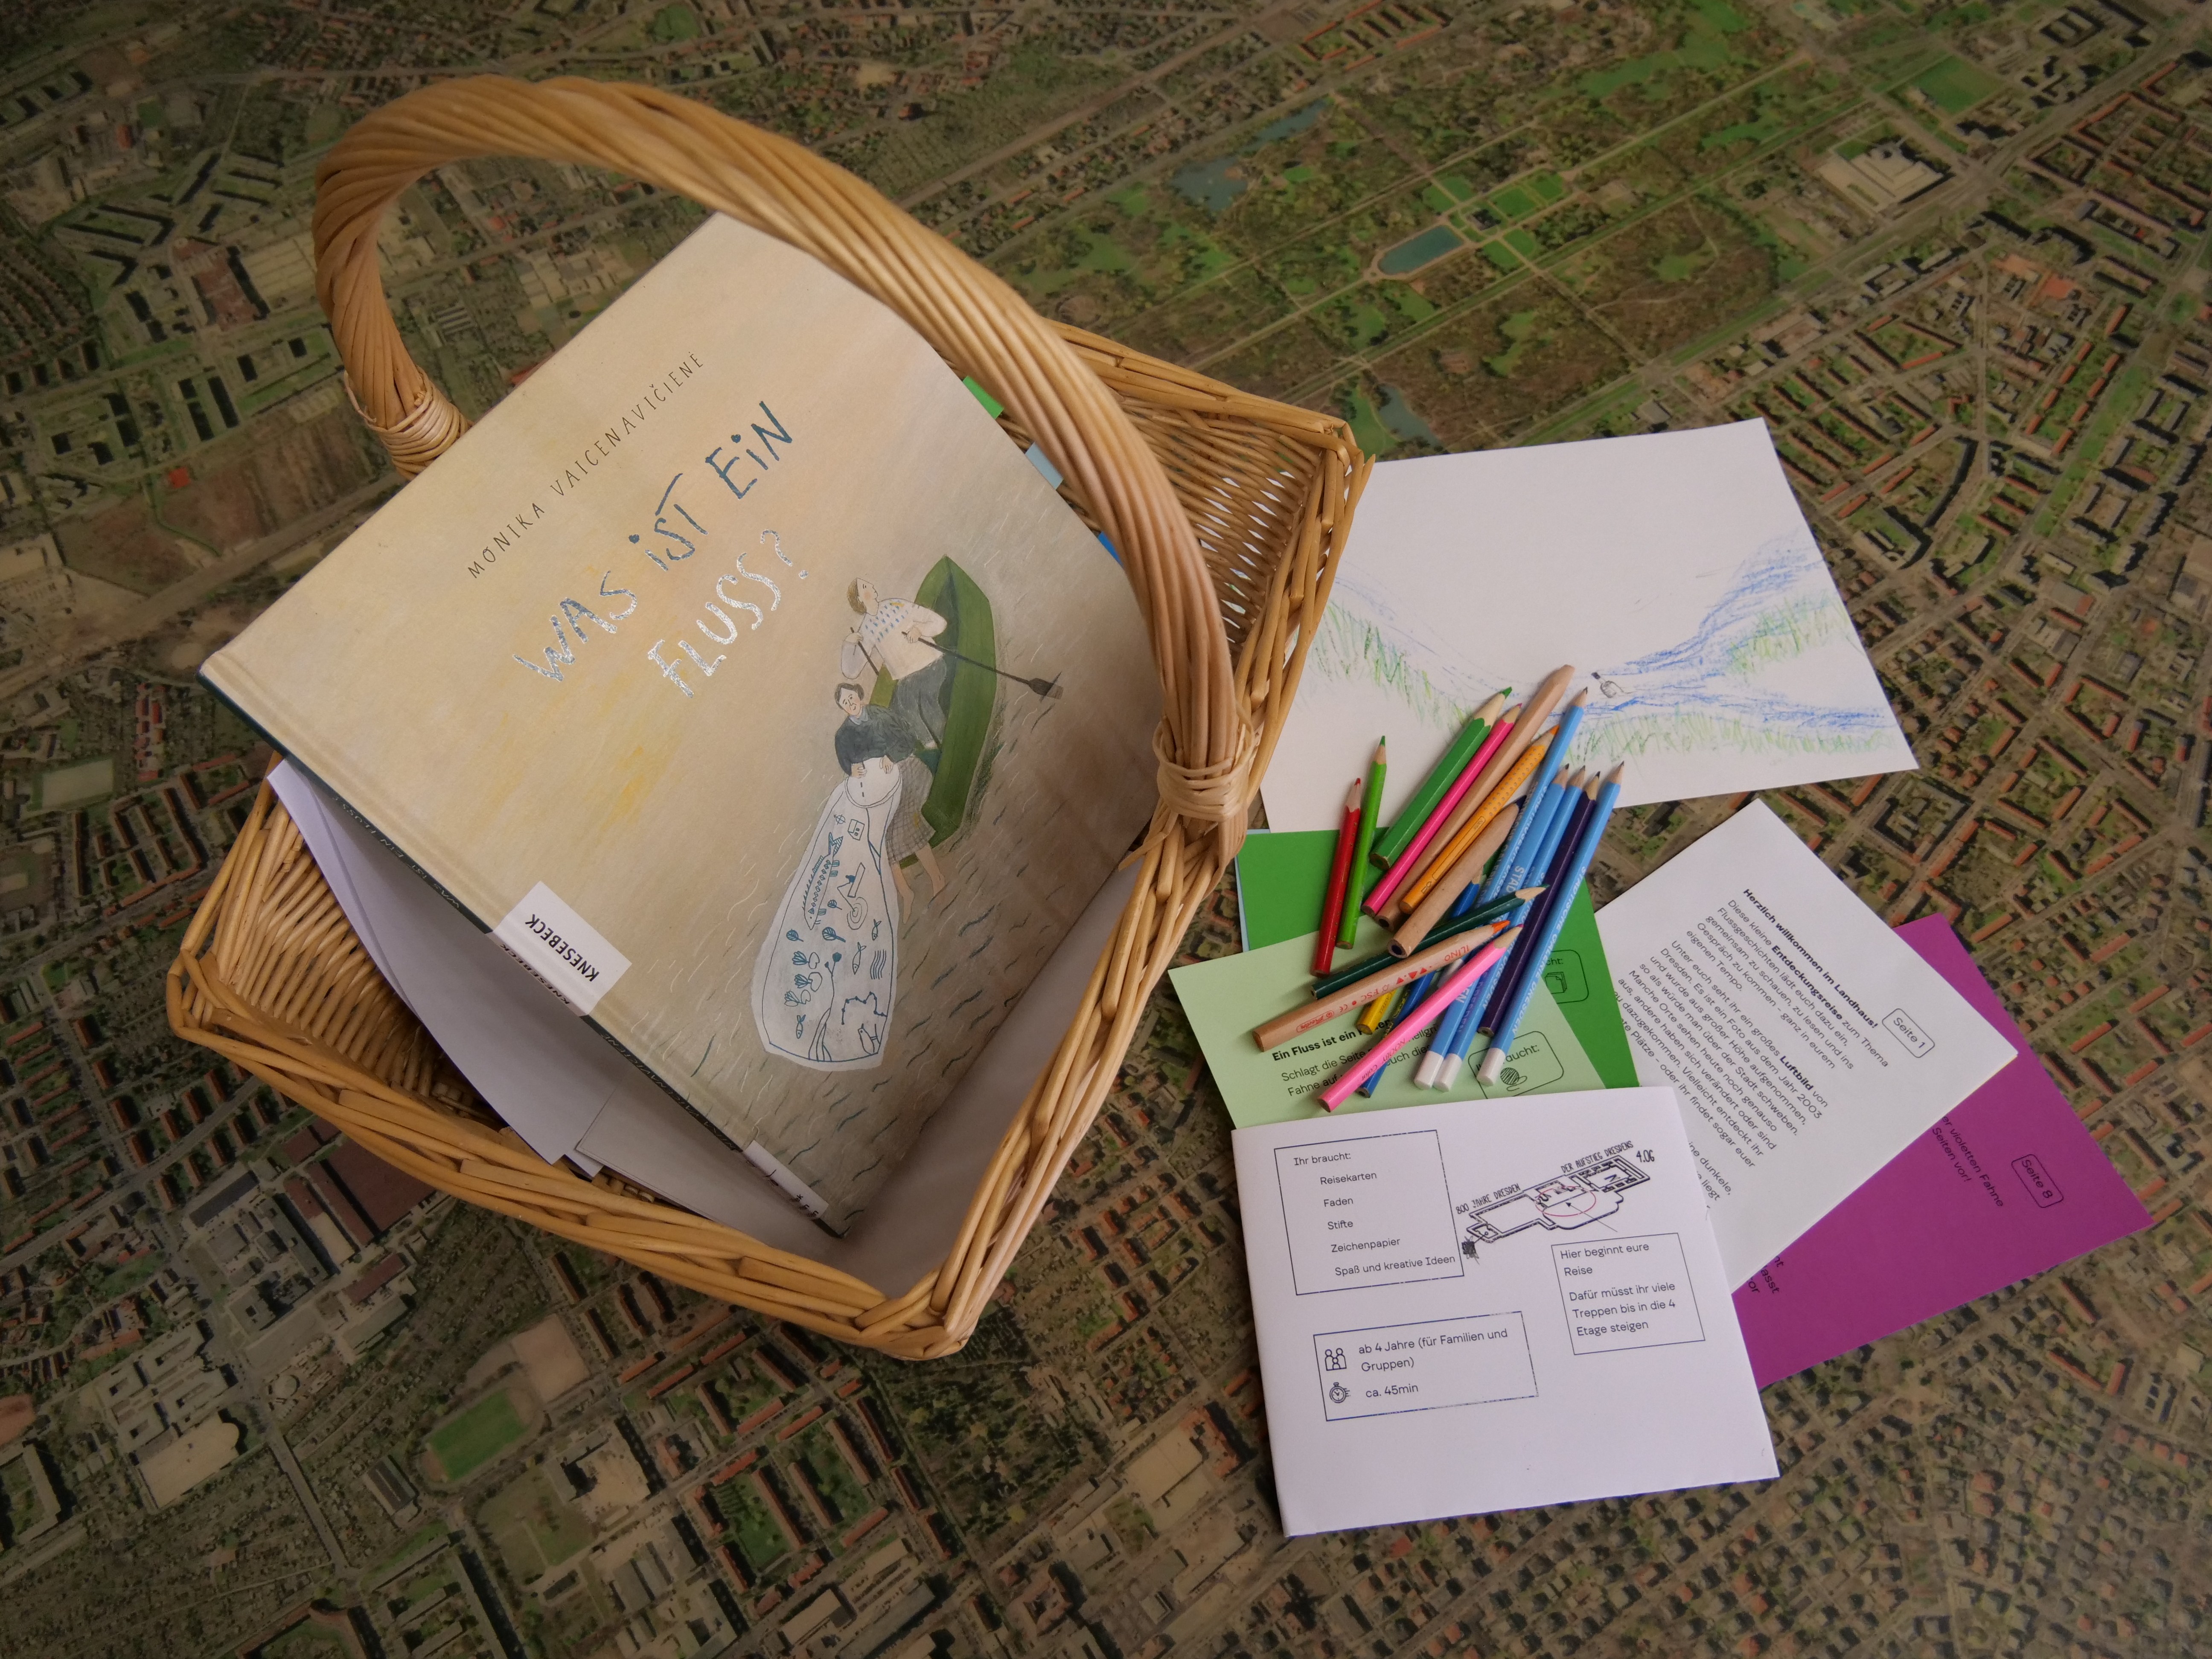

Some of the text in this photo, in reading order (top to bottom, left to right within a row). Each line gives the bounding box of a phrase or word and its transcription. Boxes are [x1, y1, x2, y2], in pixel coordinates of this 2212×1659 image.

[467, 502, 545, 579] MONIKA
[512, 570, 638, 683] WAS
[525, 913, 601, 982] KNESEBECK
[1686, 931, 1742, 991] eigenen Tempo.
[1743, 889, 1877, 1028] Herzlich willkommen im Landhaus!
[500, 943, 571, 1006] KNESEBECK
[1706, 916, 1853, 1069] gemeinsam schauen, lesen und ins
[1717, 908, 1847, 1046] Flussgeschichten lädt euch dazu ein,
[1728, 900, 1887, 1066] Diese kleine Entdeckungsreise zum Thema
[1360, 989, 1379, 1001] FSC
[1511, 981, 1538, 1034] DRESDEN
[1697, 923, 1834, 1068] Gespräch kommen ganz eurem
[1650, 956, 1805, 1125] und wurde großer Höhe aufgenommen,
[1660, 948, 1822, 1118] Dresden. ein Foto aus dem Jahr 2003
[1672, 940, 1827, 1107] Unter euch seht ihr ein großes Luftbild von
[1893, 1017, 1917, 1042] Seite
[1272, 1031, 1356, 1061] Ein Fluss ist ein
[1618, 979, 1633, 995] aus,
[1634, 996, 1660, 1023] andere
[1660, 1023, 1684, 1050] haben
[1684, 1051, 1701, 1068] sich
[1701, 1068, 1738, 1109] verändert
[1738, 1110, 1758, 1129] oder
[1757, 1131, 1776, 1149] sind
[1629, 970, 1776, 1131] Manche Orte sehen heute noch genauso
[1662, 987, 1797, 1135] würde man über der Stadt schweben.
[1281, 1059, 1341, 1081] Schlagt die
[1287, 1074, 1338, 1096] Fahne auf
[1622, 1003, 1752, 1144] dazugekommen. Vielleicht entdeckt
[1630, 1030, 1654, 1057] Plätze
[1660, 1064, 1679, 1083] oder
[1678, 1083, 1690, 1095] ihr
[1689, 1096, 1713, 1122] findet
[1712, 1122, 1736, 1145] sogar
[1735, 1148, 1755, 1166] euer
[1293, 1153, 1350, 1165] Ihr braucht:
[1561, 1140, 1634, 1174] DER AUFSTIEG DRESDENS
[1932, 1127, 1972, 1182] Seiten vor!
[1950, 1129, 2003, 1206] violetten Fahne
[1320, 1173, 1377, 1185] Reisekarten
[1697, 1157, 1732, 1196] dunkele,
[1703, 1179, 1720, 1201] liegt
[2022, 1159, 2053, 1198] Seite 8
[1324, 1198, 1353, 1207] Faden
[1456, 1203, 1469, 1214] 800
[1493, 1183, 1521, 1201] DRESDEN
[1327, 1220, 1353, 1229] Stifte
[1330, 1238, 1400, 1252] Zeichenpapier
[1560, 1244, 1649, 1259] Hier beginnt eure
[1335, 1256, 1455, 1276] Spaß und kreative Ideen
[1564, 1266, 1592, 1276] Reise
[1569, 1282, 1675, 1301] Dafür müsst ihr viele
[1572, 1299, 1675, 1318] Treppen bis in die 4
[1359, 1328, 1508, 1353] ab 4 Jahre (für Familien und
[1577, 1321, 1648, 1336] Etage steigen
[1361, 1356, 1414, 1371] Gruppen)
[1384, 1383, 1418, 1394] 45min
